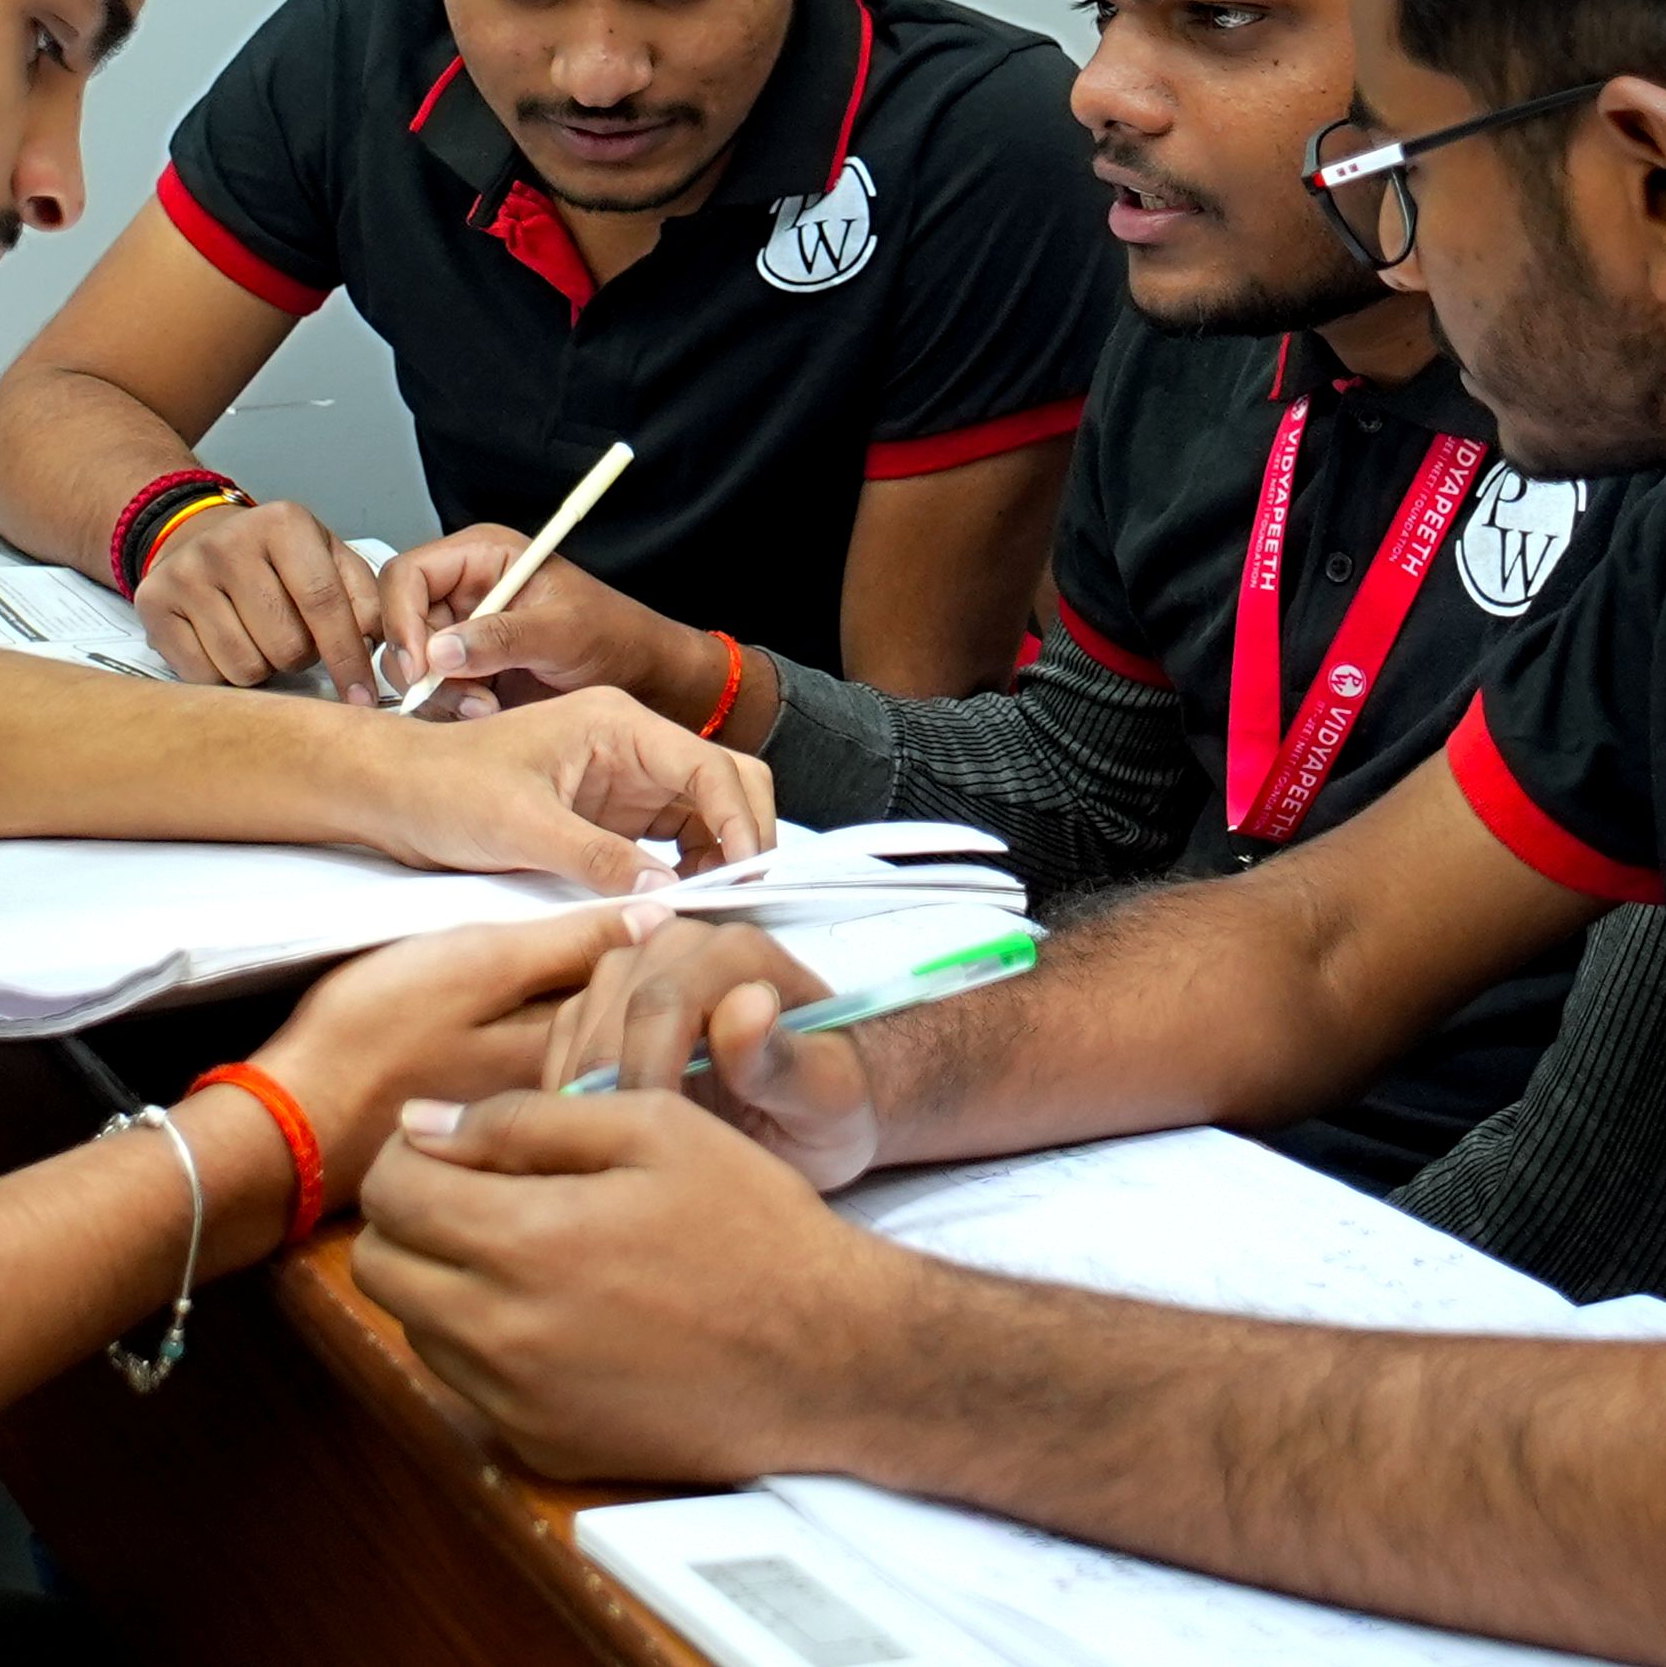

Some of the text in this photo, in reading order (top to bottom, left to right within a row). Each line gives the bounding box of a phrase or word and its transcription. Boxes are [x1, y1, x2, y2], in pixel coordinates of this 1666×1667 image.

[1259, 428, 1301, 591] VIDYAPEETH
[1389, 493, 1428, 562] FOUNDATION
[1401, 437, 1484, 577] IDYAPEETH
[1426, 461, 1444, 488] NEET
[1266, 707, 1352, 838] VIDYAPEETH
